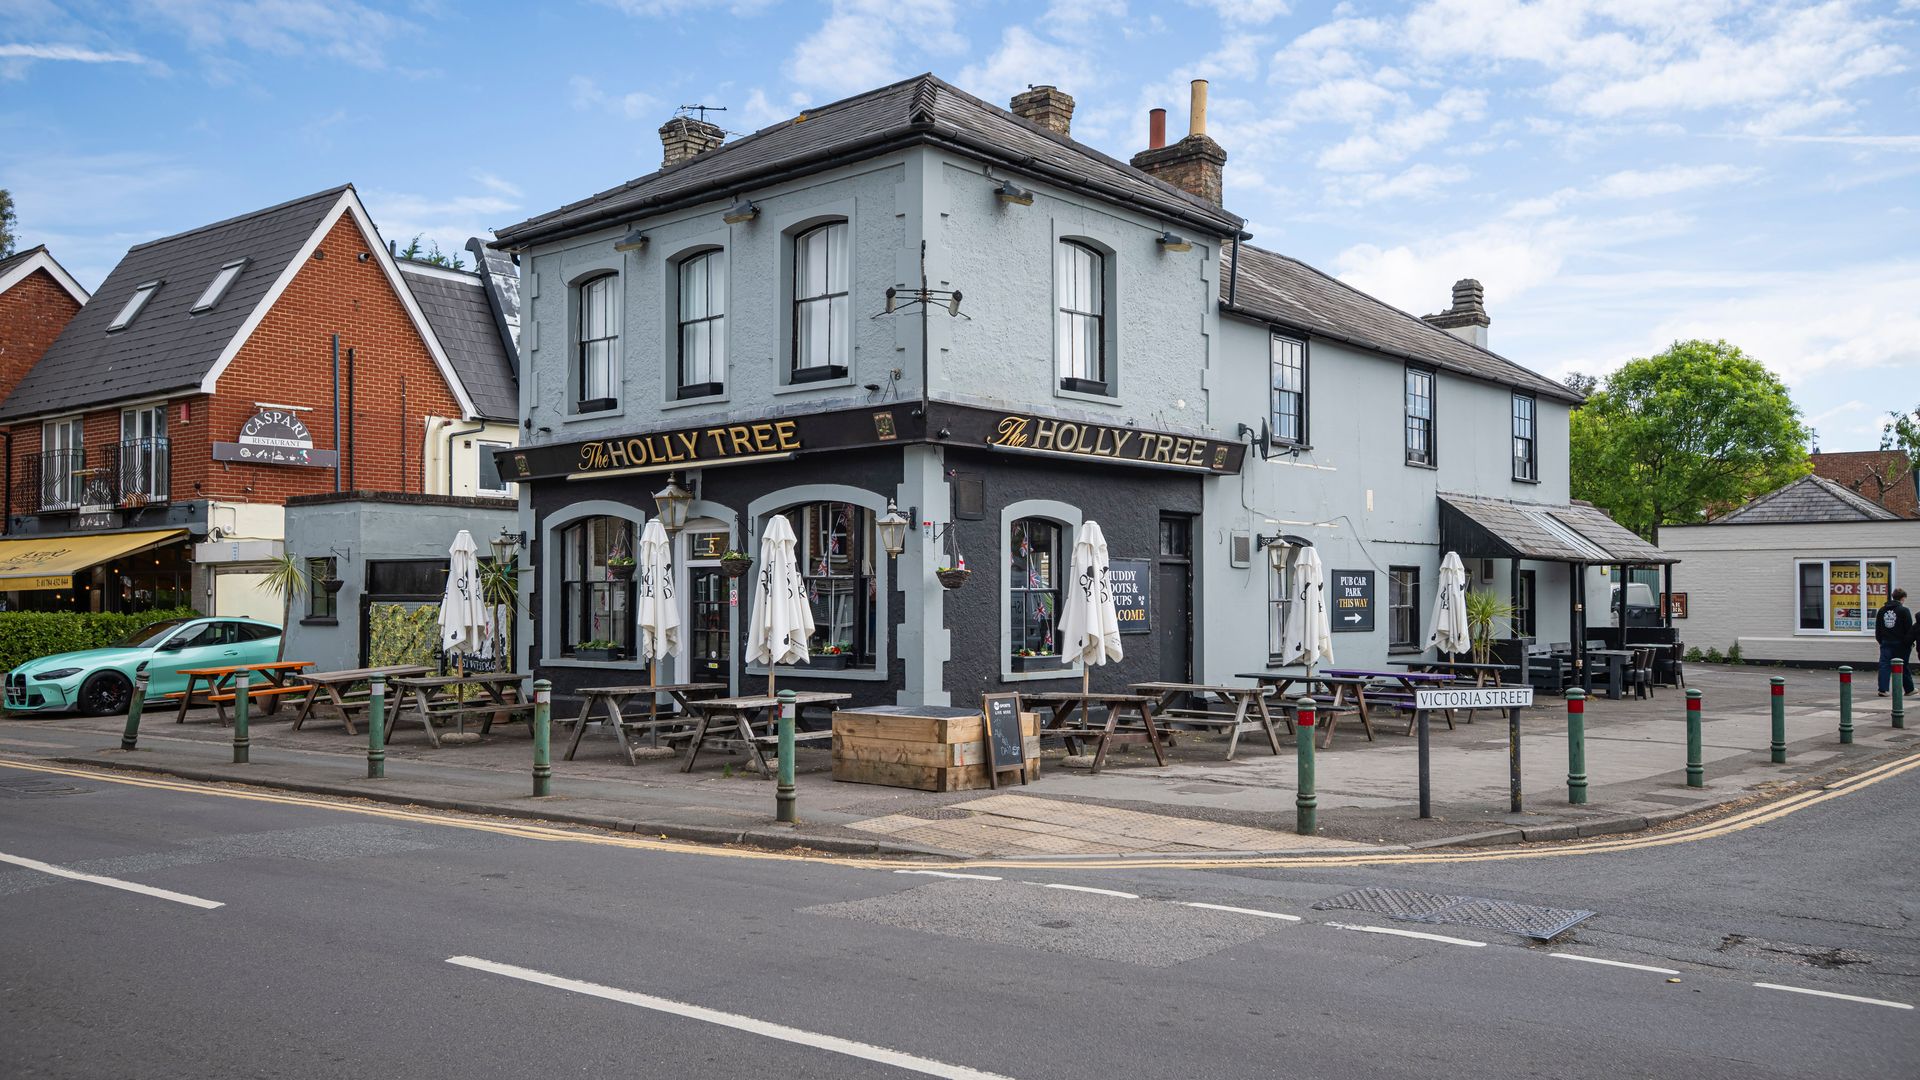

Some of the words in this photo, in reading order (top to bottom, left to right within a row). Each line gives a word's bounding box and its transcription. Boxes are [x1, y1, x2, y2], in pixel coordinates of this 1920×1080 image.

[245, 412, 308, 439] CASPARI
[252, 437, 301, 447] RESTAURANT
[578, 441, 609, 470] The
[607, 431, 699, 467] HOLLY
[707, 420, 801, 456] TREE
[986, 416, 1031, 447] The
[1031, 418, 1133, 457] HOLLY
[1138, 432, 1208, 466] TREE
[708, 540, 715, 554] 5
[1340, 576, 1353, 586] PUB
[1353, 576, 1367, 586] CAR
[1110, 583, 1131, 593] OOTS
[1132, 583, 1139, 594] &
[1345, 587, 1362, 597] PARK
[1830, 584, 1853, 594] FOR
[1856, 584, 1887, 594] SALE
[1339, 598, 1354, 608] THIS
[1354, 598, 1368, 608] WAY
[1116, 609, 1145, 621] COME
[1420, 691, 1482, 706] VICTORIA
[1486, 690, 1530, 705] STREET
